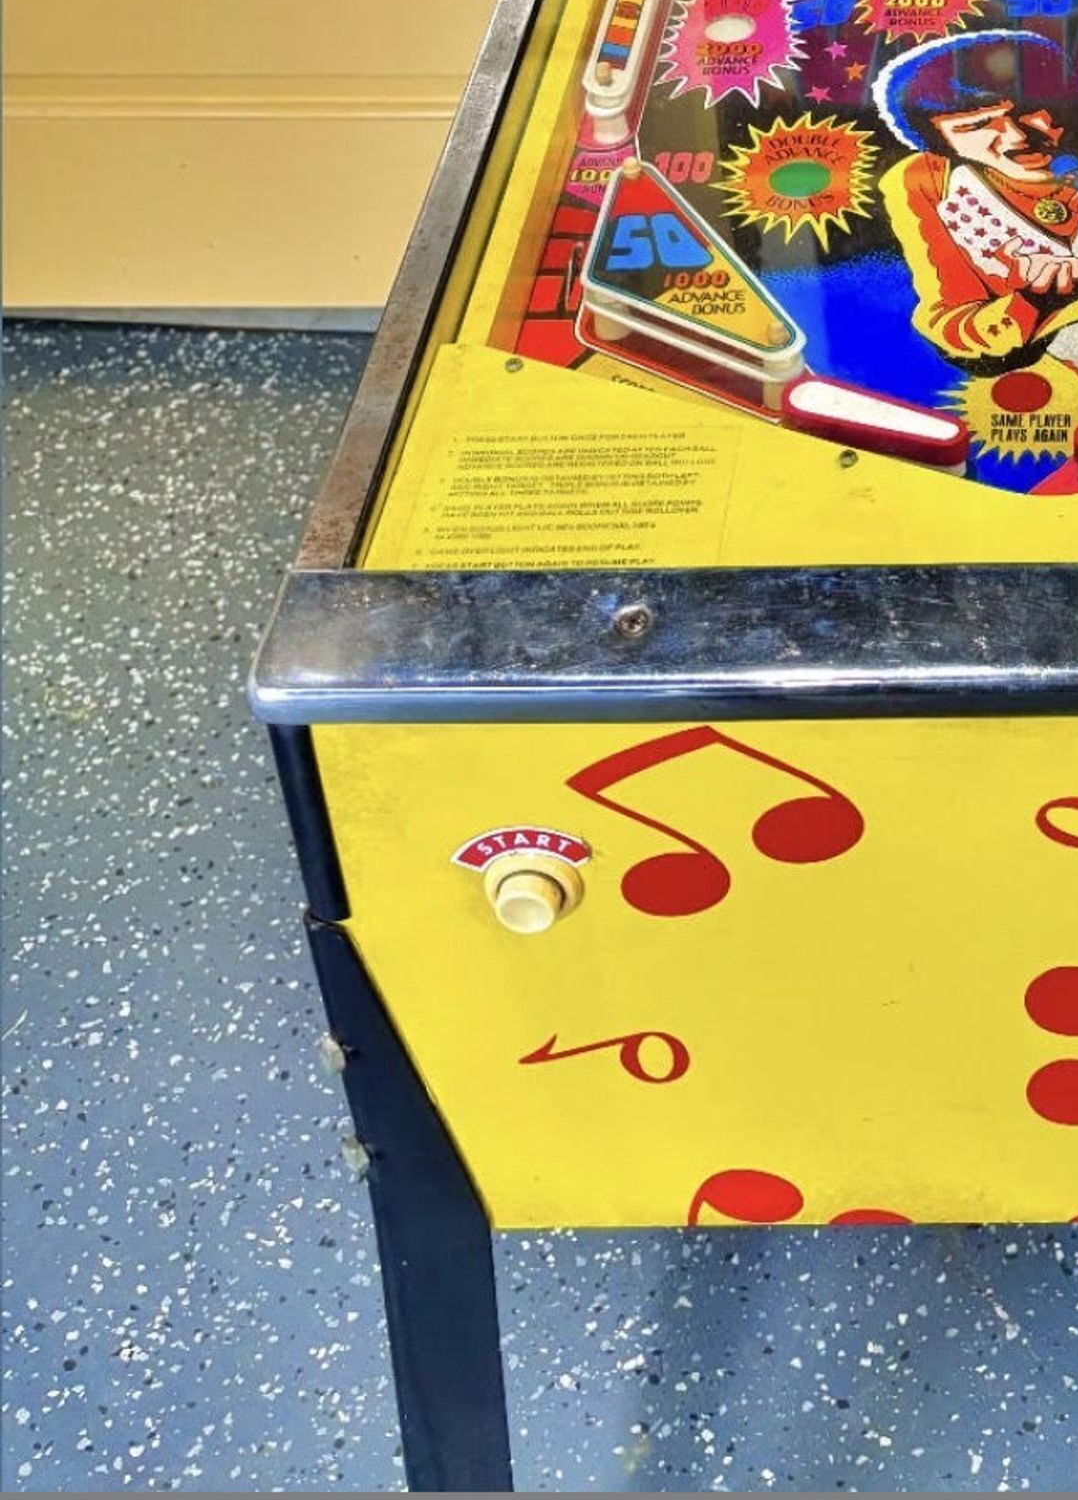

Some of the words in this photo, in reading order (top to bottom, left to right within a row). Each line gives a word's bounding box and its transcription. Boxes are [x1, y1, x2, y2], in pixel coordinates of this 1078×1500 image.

[653, 151, 715, 184] 100
[604, 212, 715, 271] 50
[663, 269, 731, 288] 1000
[667, 289, 747, 304] ADVANCE
[691, 302, 747, 316] BONUS
[990, 414, 1023, 428] SAME
[1028, 414, 1072, 428] PLAYER
[990, 428, 1028, 443] PLAYS
[1032, 428, 1069, 443] AGAIN
[476, 832, 572, 857] START
